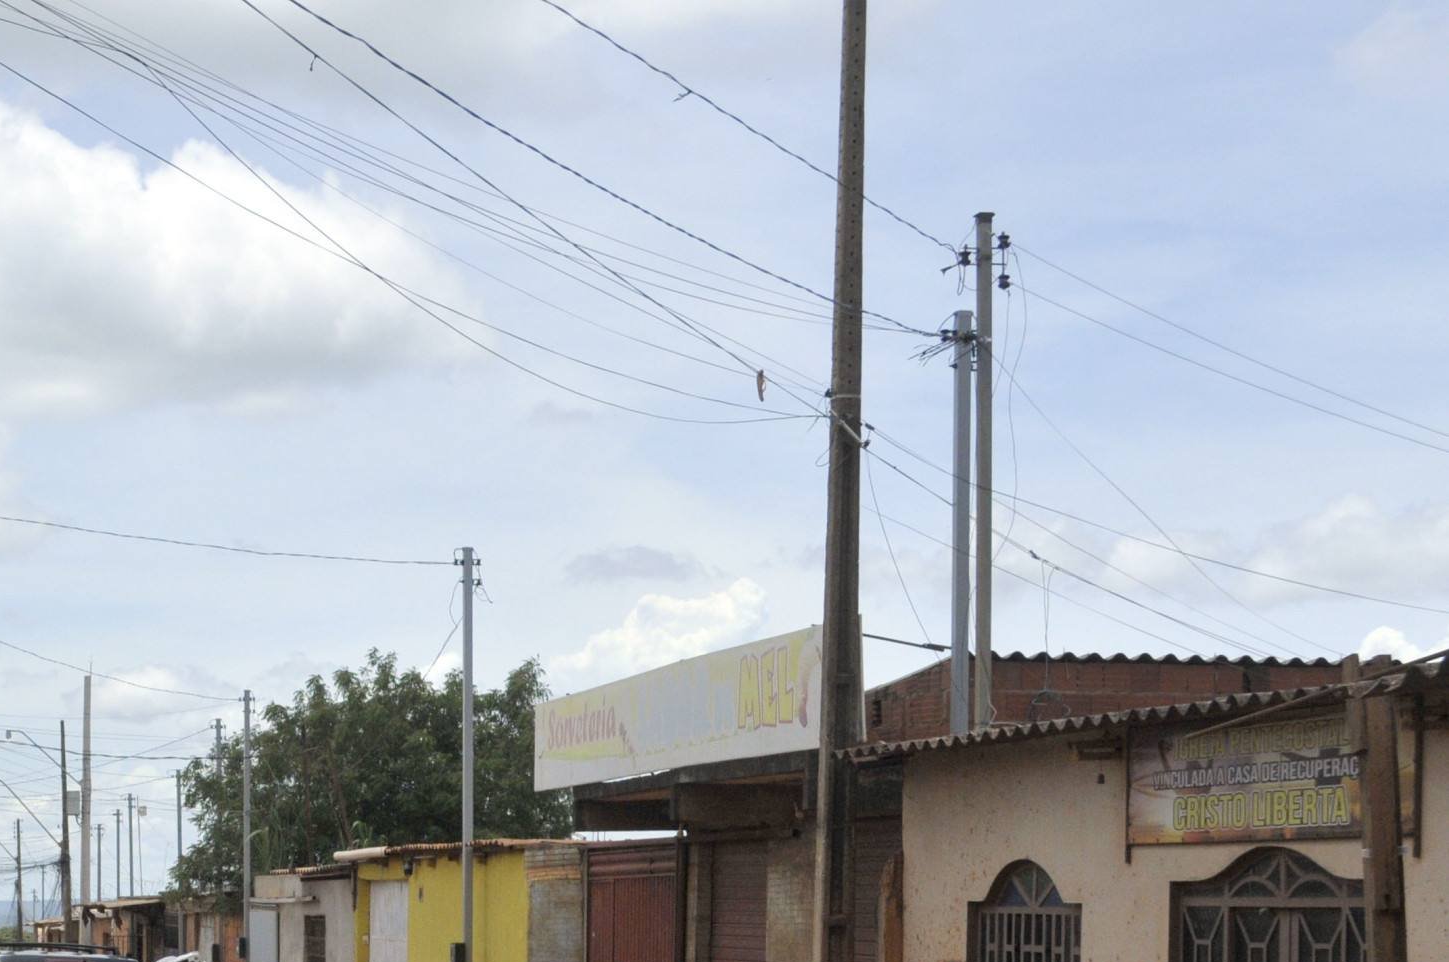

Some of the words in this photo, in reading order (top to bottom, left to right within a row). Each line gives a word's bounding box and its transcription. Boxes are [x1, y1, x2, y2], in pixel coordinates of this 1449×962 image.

[737, 644, 795, 731] MEL
[1230, 718, 1351, 755] PENTECOSTAL
[1153, 768, 1214, 790] VINCULADA
[1227, 762, 1259, 785] CASA
[1261, 760, 1279, 783] DE
[1281, 756, 1359, 781] RECUPERAÇ
[1173, 792, 1248, 831] CRISTO
[1252, 786, 1350, 828] LIBERTA
